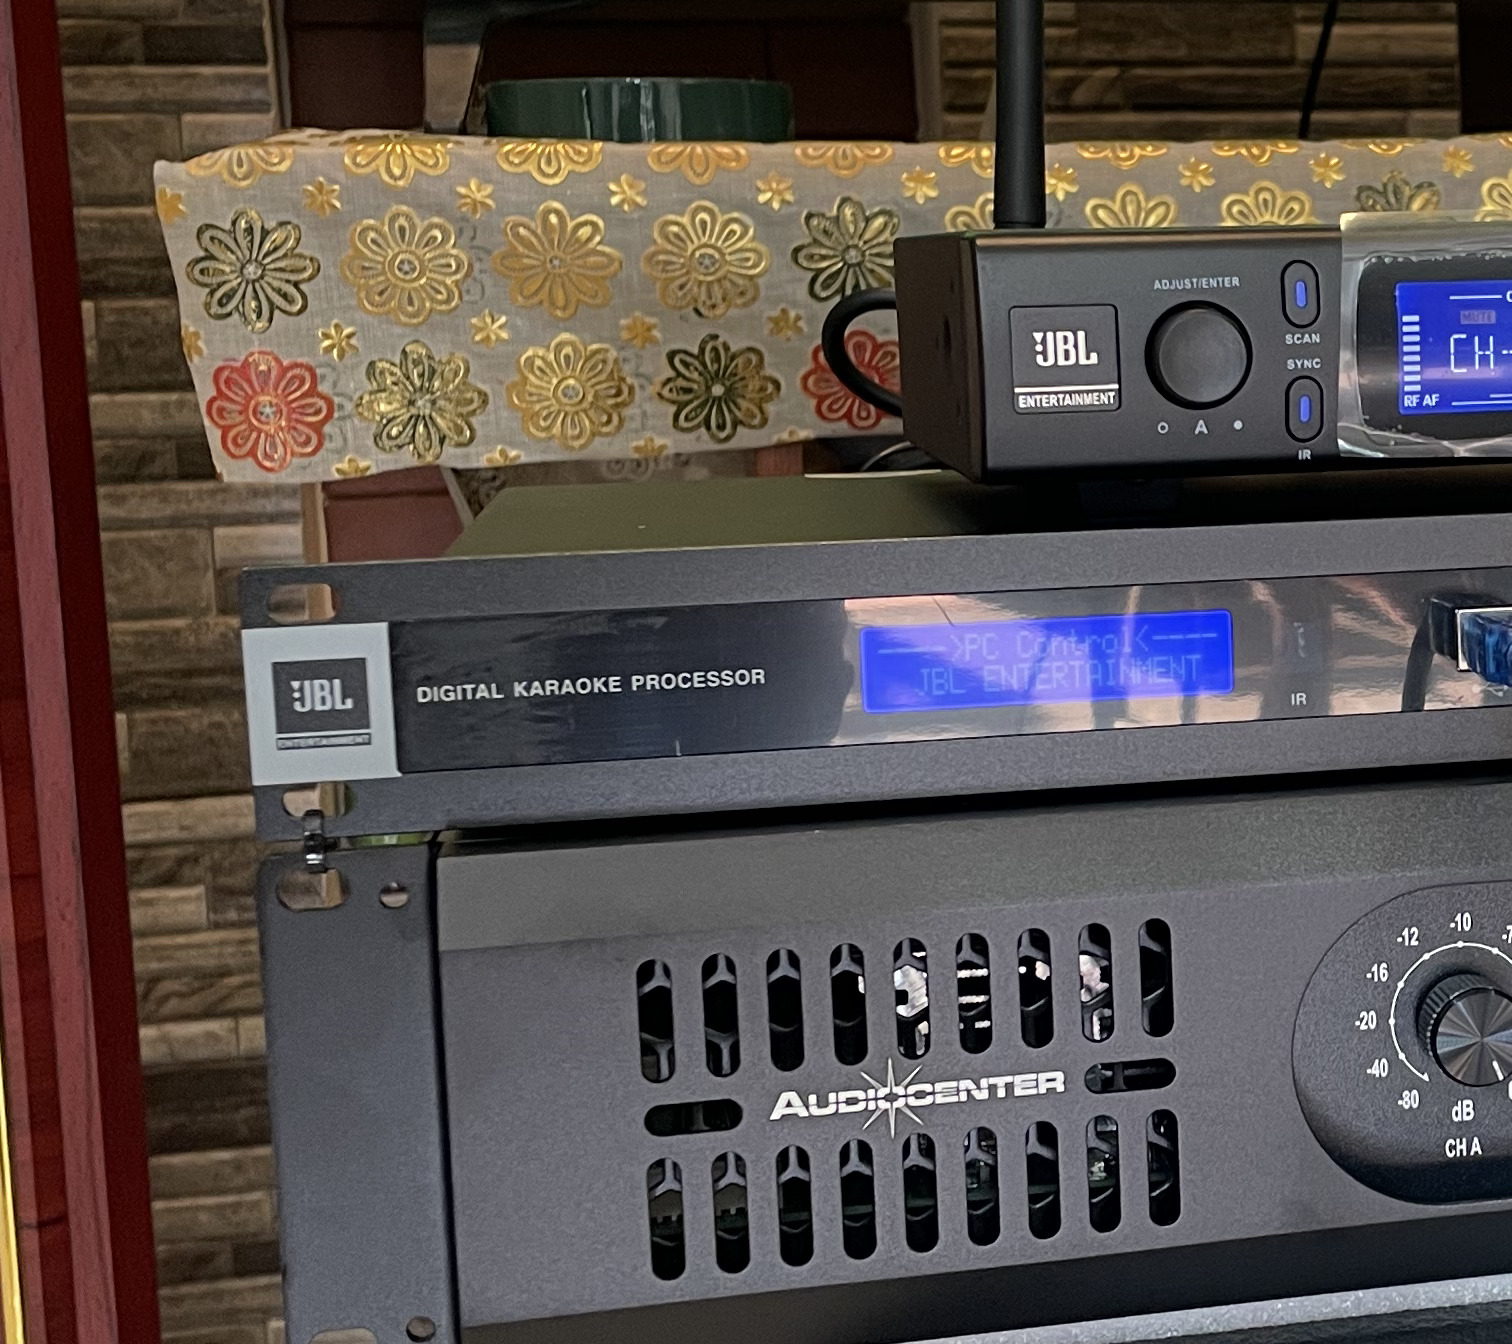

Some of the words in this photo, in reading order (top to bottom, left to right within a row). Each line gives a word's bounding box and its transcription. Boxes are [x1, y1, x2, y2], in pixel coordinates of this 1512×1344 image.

[1153, 276, 1240, 290] ADJUST/ENTER
[1033, 330, 1098, 367] JBL
[1285, 333, 1321, 345] SCAN
[1286, 358, 1322, 370] SYNC
[1018, 391, 1116, 408] ENTERTAINMENT
[1404, 394, 1419, 408] RF
[1422, 393, 1440, 407] AF
[1194, 420, 1209, 435] A
[1298, 449, 1312, 460] IR
[917, 667, 967, 697] JBL
[983, 654, 1202, 694] ENTERTAINMENT
[416, 682, 504, 703] DIGITAL
[513, 676, 622, 698] KARAOKE
[631, 668, 766, 691] PROCESSOR
[290, 679, 353, 712] JBL
[1291, 692, 1307, 706] IR
[1450, 913, 1472, 932] -10
[1397, 927, 1419, 947] -12
[1366, 963, 1388, 983] -16
[1355, 1011, 1377, 1030] -20
[1367, 1058, 1388, 1078] -40
[1398, 1090, 1419, 1109] -80
[1452, 1100, 1475, 1122] dB
[1445, 1138, 1467, 1158] CH
[1469, 1136, 1483, 1156] A
